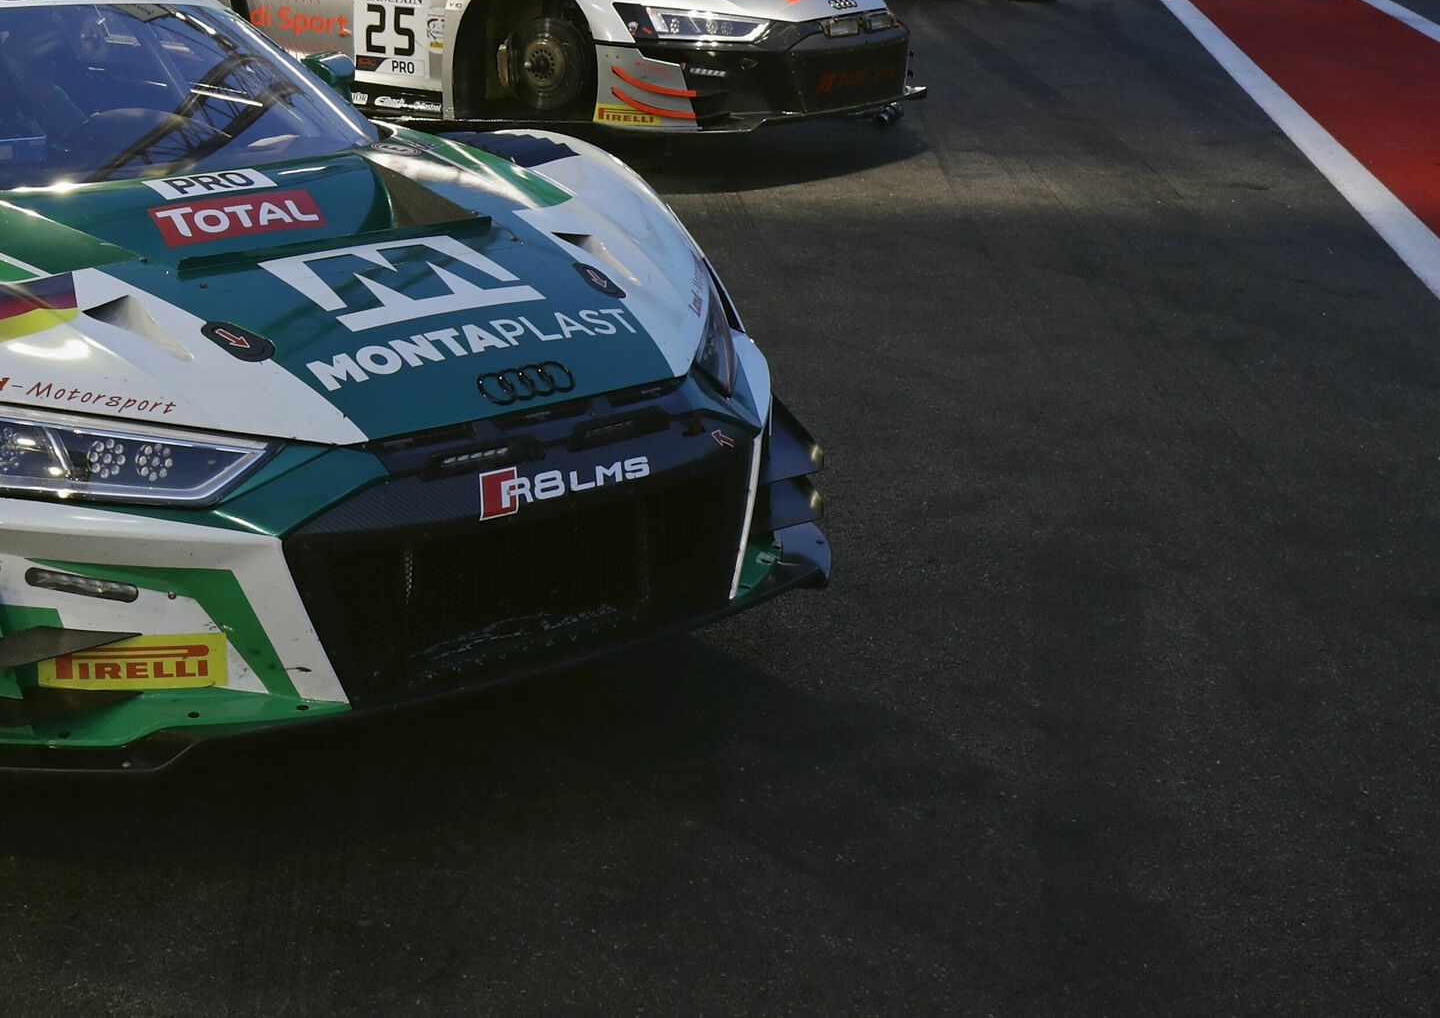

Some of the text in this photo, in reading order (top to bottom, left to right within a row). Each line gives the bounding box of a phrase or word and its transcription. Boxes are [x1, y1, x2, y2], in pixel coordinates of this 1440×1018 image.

[250, 6, 351, 37] di Sport
[365, 3, 416, 57] 25
[391, 60, 415, 74] PRO
[598, 106, 656, 125] PIRELLI
[170, 169, 257, 195] PRO
[155, 198, 321, 239] TOTAL
[305, 308, 640, 392] MONTAPLAST
[24, 380, 178, 416] Motorsport
[500, 455, 652, 510] R8 LMS
[53, 644, 210, 681] PIRELLI
